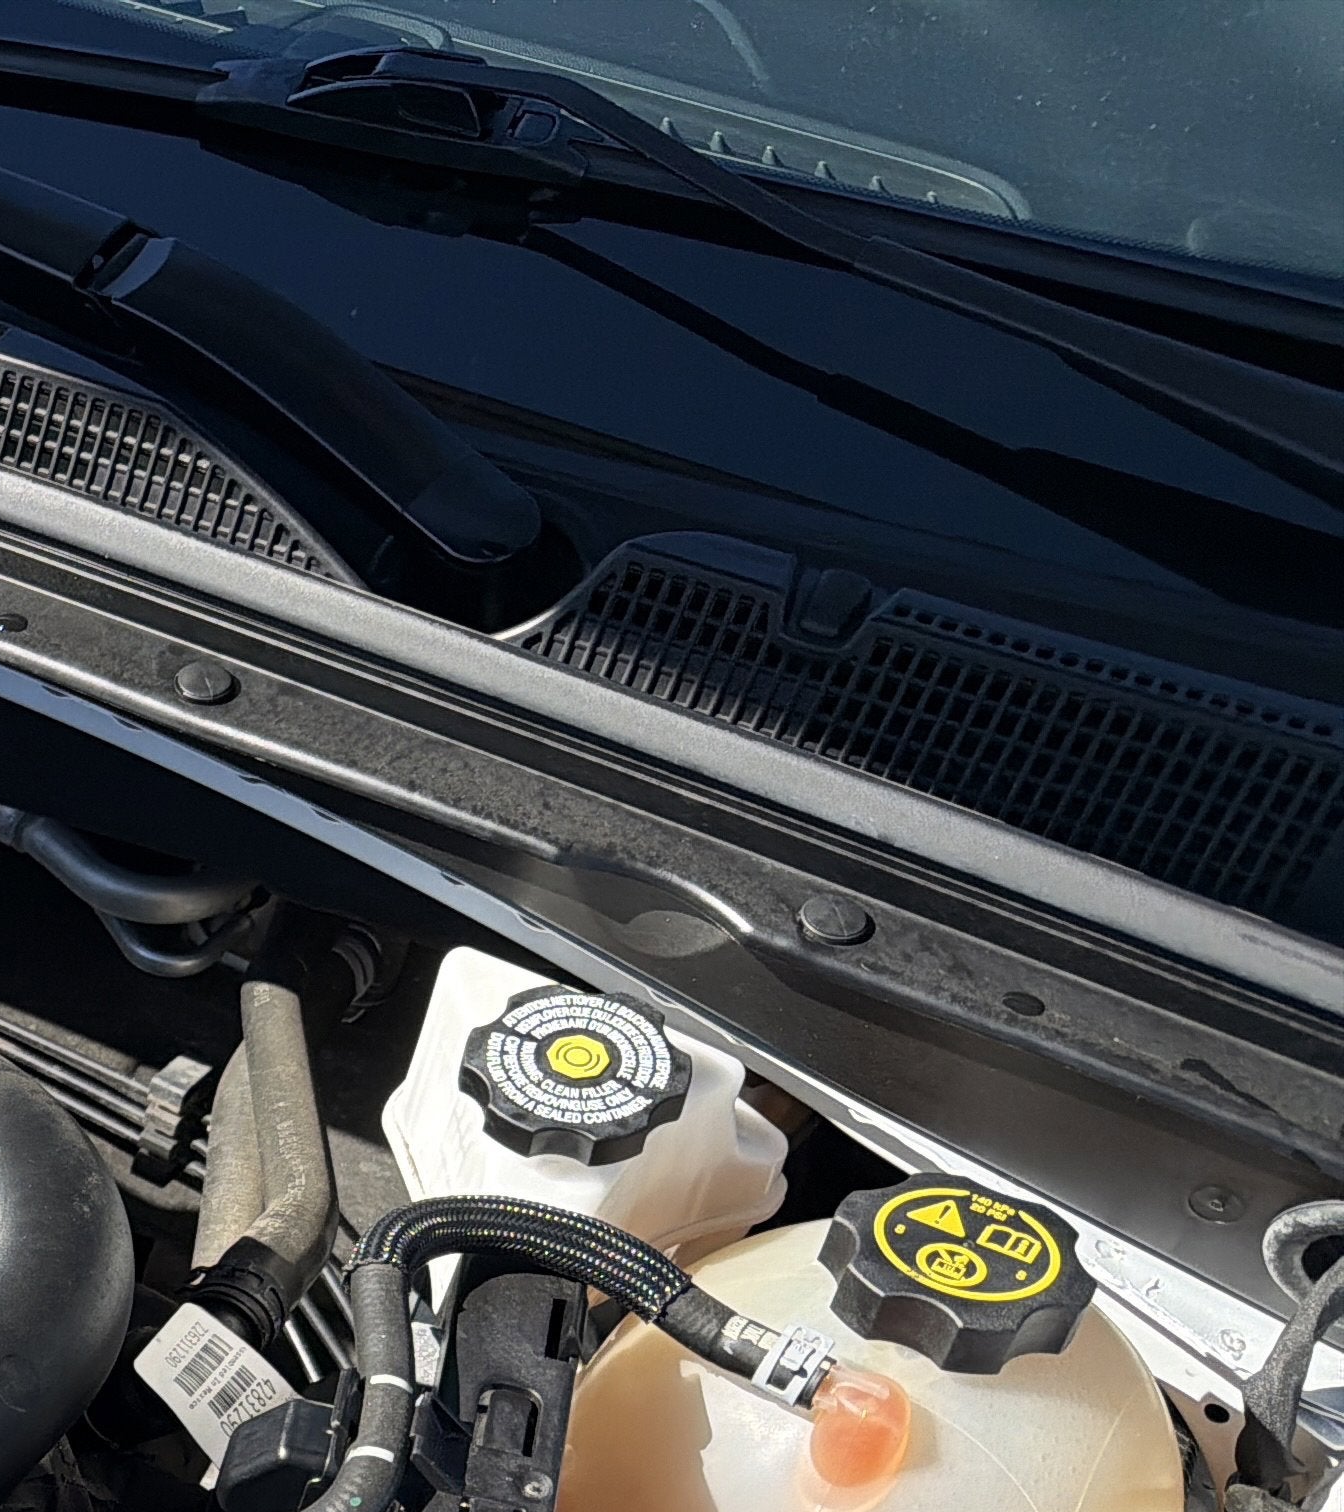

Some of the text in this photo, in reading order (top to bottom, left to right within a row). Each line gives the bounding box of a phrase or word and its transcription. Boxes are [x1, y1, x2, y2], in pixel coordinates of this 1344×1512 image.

[541, 1079, 579, 1098] CLEAN
[582, 1080, 622, 1099] FILLER
[605, 1087, 634, 1106] ONLY
[498, 1081, 529, 1106] FROM
[533, 1104, 582, 1123] SEALED
[972, 1194, 992, 1206] 140
[189, 1386, 212, 1409] Mexico
